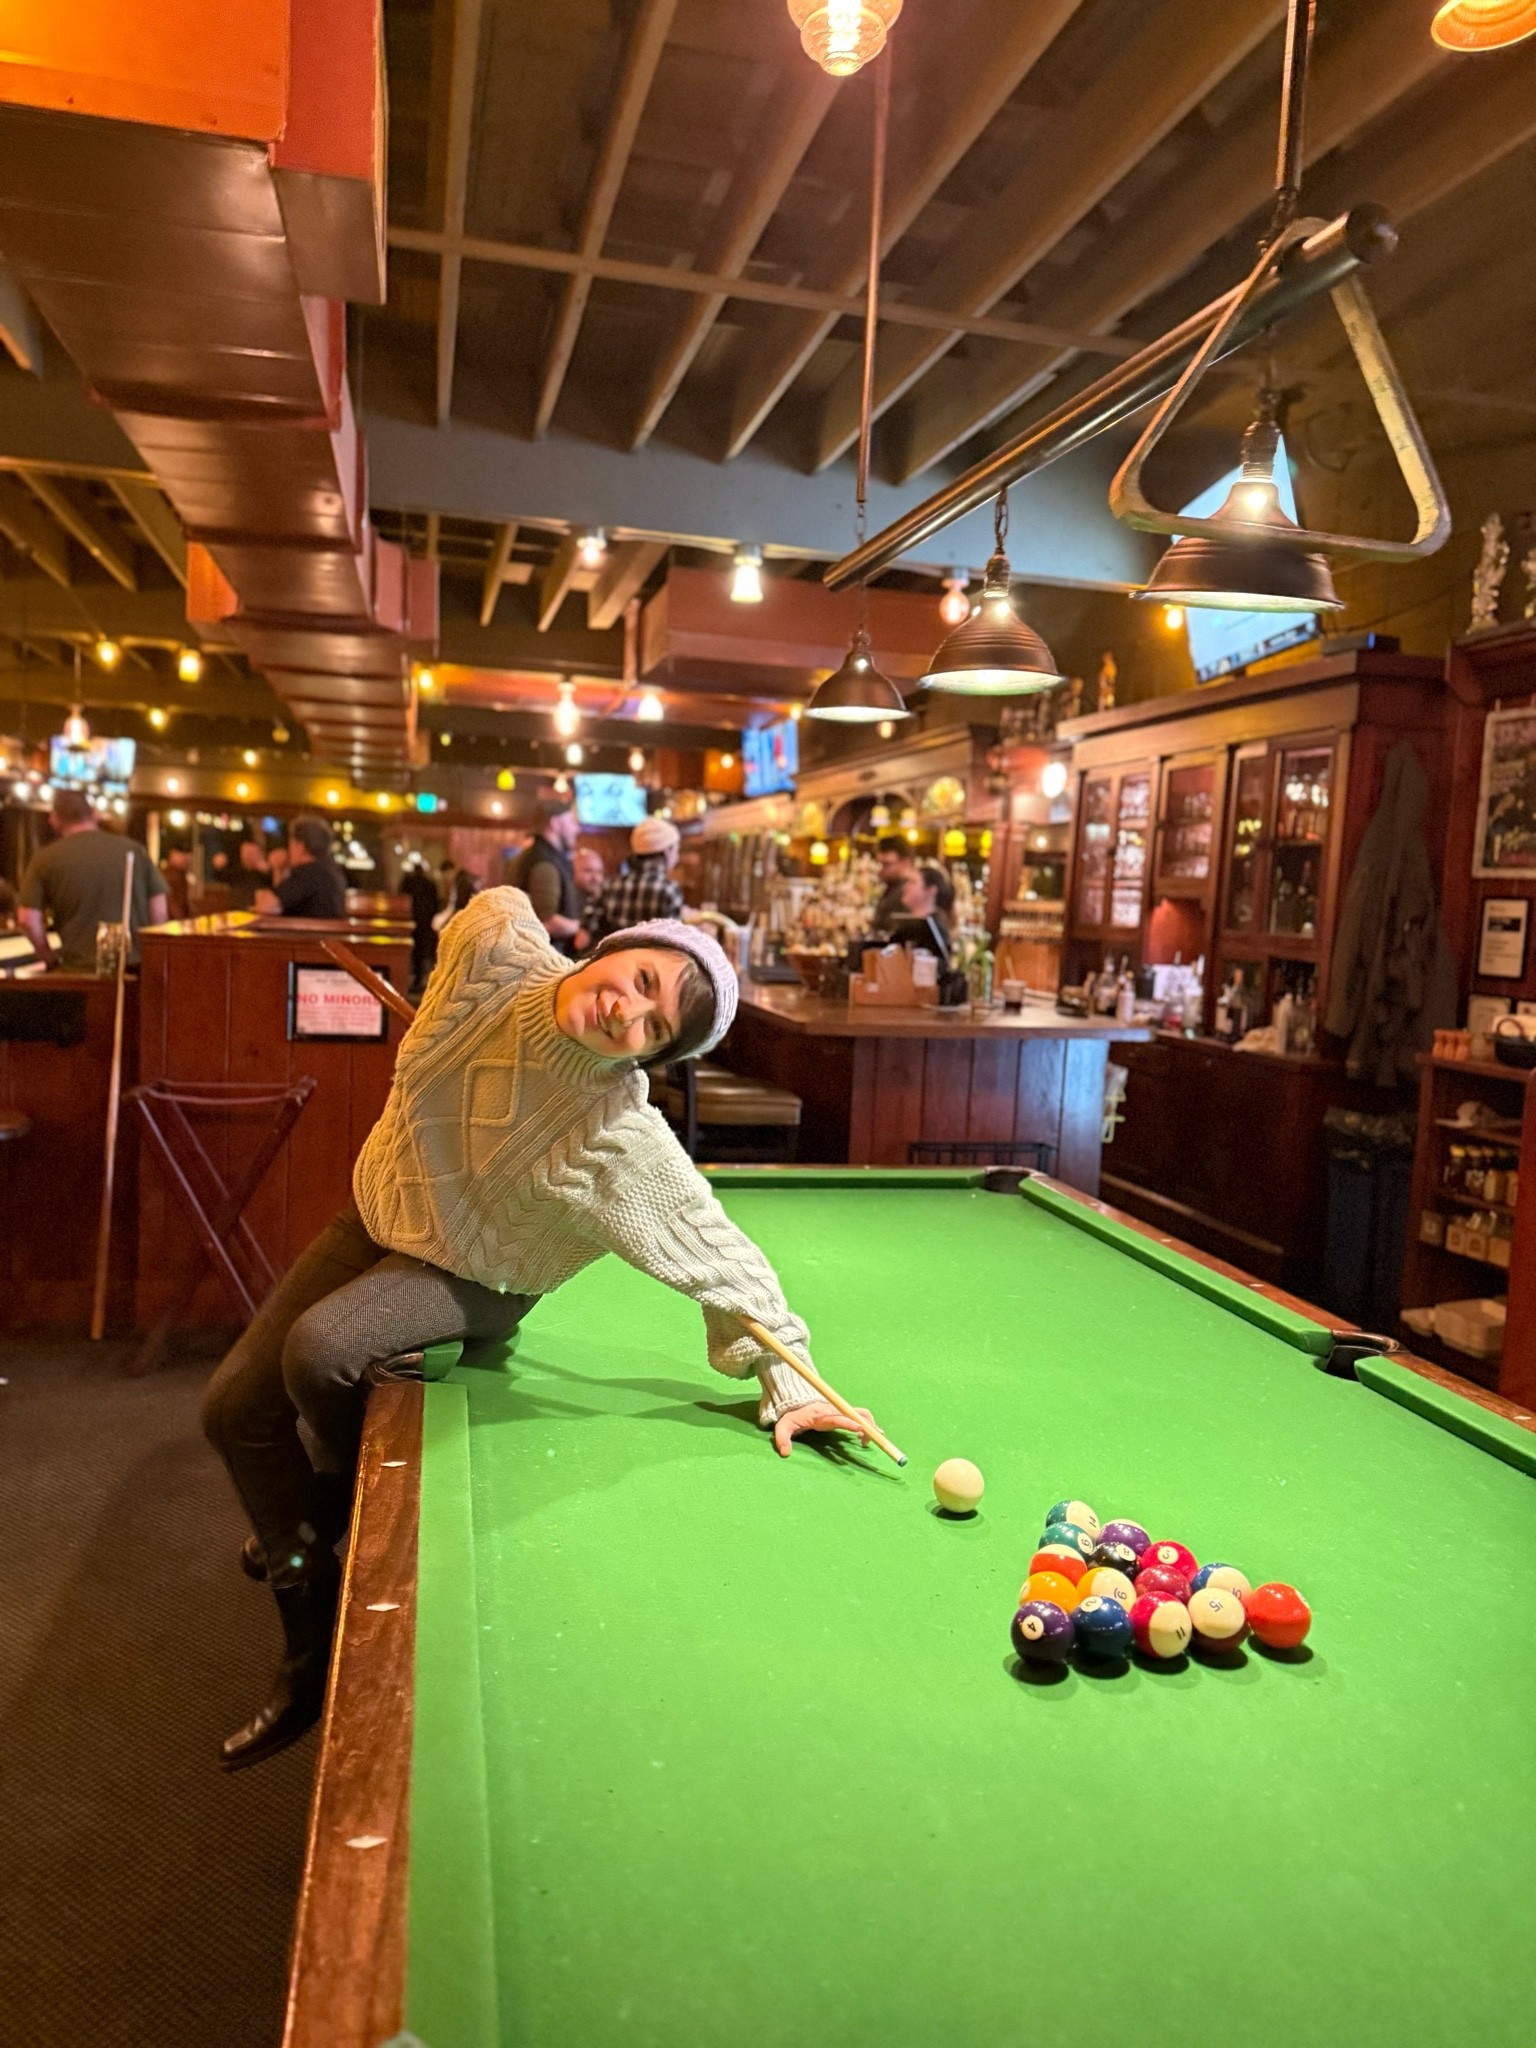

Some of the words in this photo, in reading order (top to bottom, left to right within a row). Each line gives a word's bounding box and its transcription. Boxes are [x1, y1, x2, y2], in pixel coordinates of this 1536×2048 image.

[297, 993, 318, 1003] NO
[1088, 1515, 1097, 1528] 14
[1122, 1547, 1130, 1556] 8
[1162, 1549, 1170, 1560] 3
[1085, 1599, 1097, 1607] 2
[1027, 1622, 1037, 1632] 4
[1175, 1626, 1186, 1641] 11
